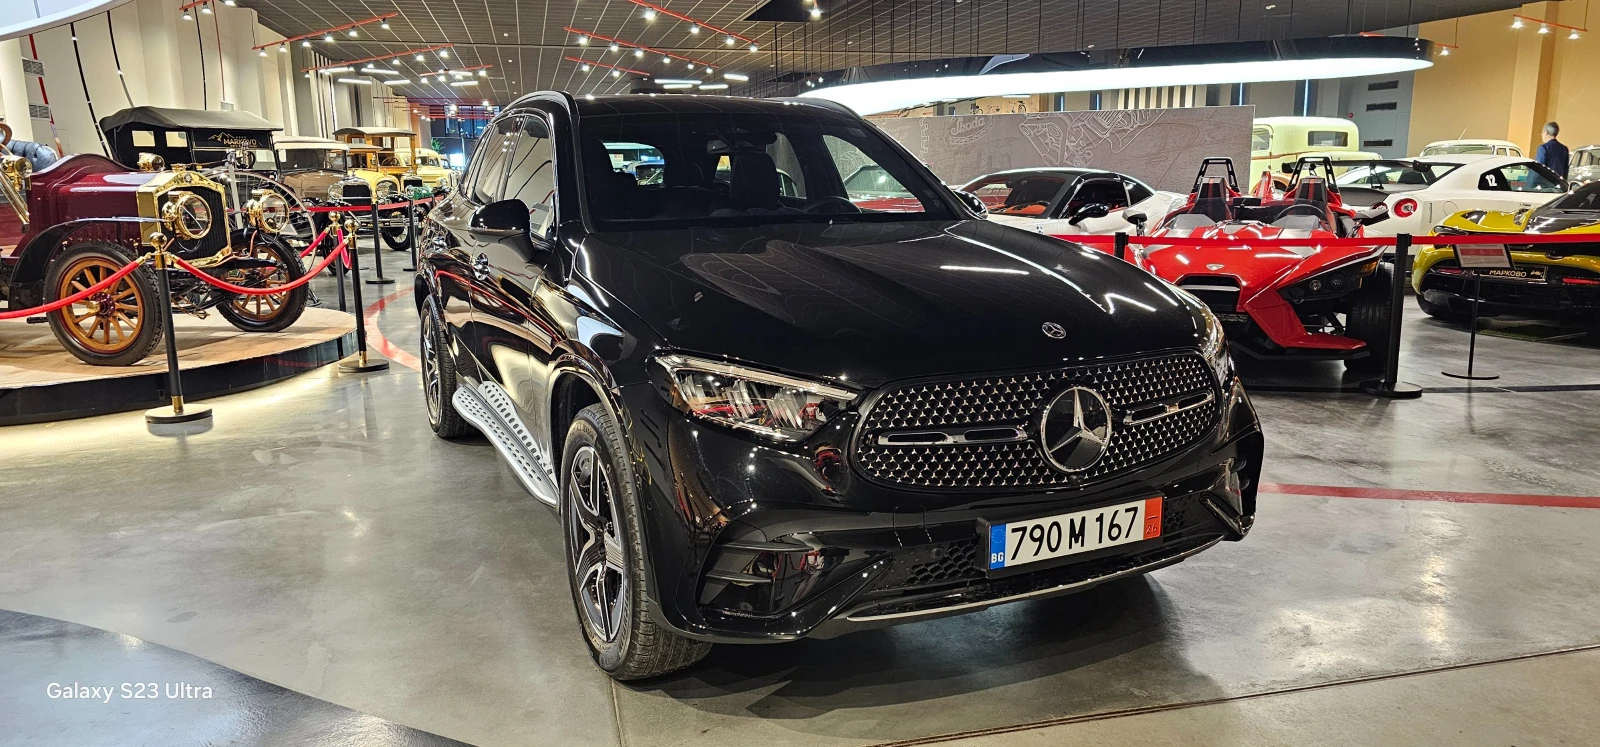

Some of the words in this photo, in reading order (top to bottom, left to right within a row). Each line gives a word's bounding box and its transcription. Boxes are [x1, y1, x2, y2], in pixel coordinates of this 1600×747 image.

[1485, 174, 1498, 187] 12
[1010, 520, 1062, 561] 790
[1068, 515, 1086, 550] M
[1095, 506, 1139, 544] 167
[1146, 524, 1158, 534] 26
[991, 552, 1004, 564] BG
